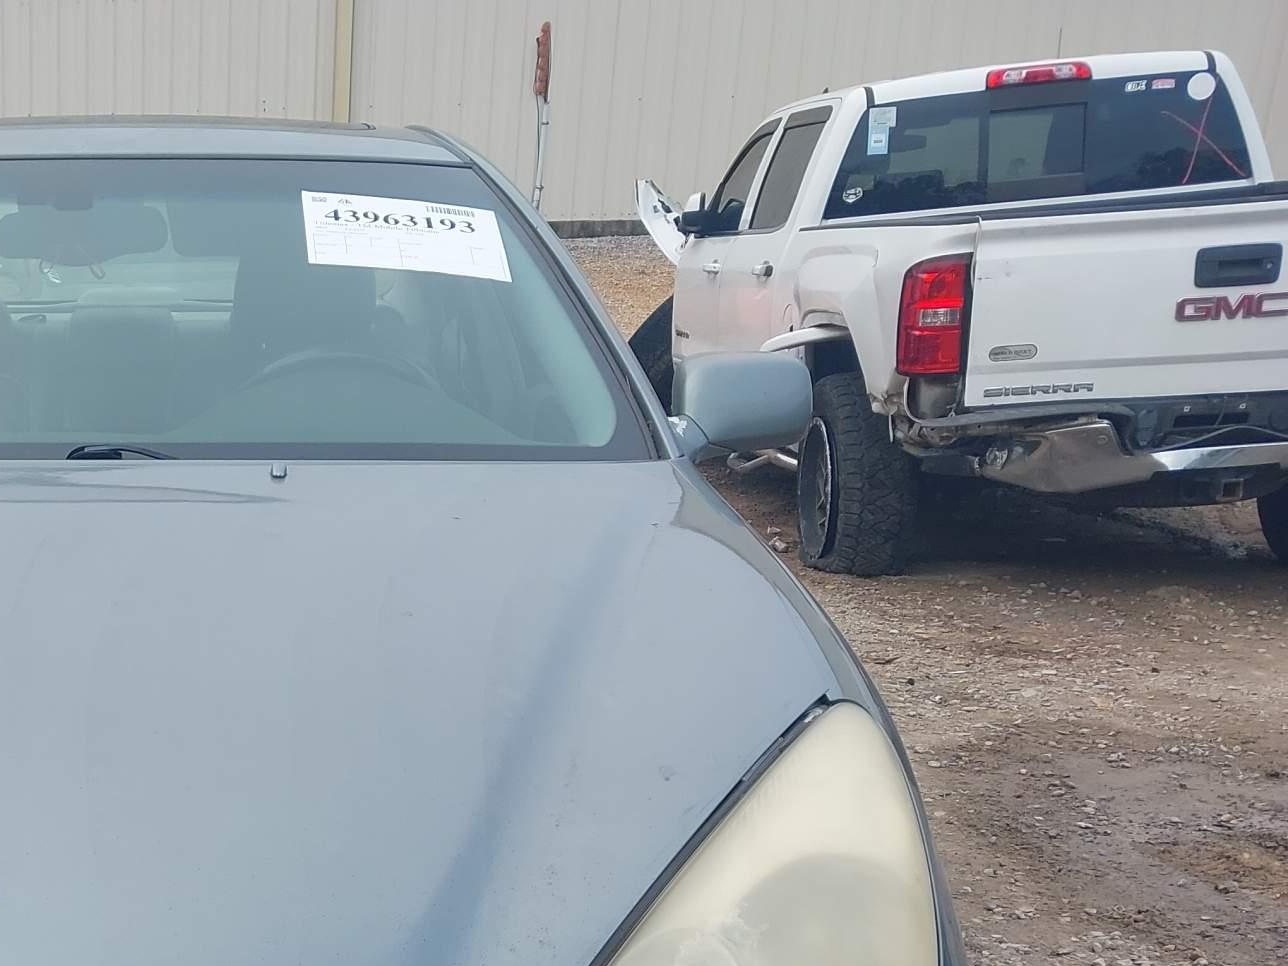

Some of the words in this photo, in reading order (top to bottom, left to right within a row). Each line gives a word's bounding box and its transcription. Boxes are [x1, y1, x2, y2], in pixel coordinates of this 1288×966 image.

[324, 208, 477, 234] 43963193
[1174, 291, 1288, 322] GMC
[983, 382, 1094, 399] SIERRA
